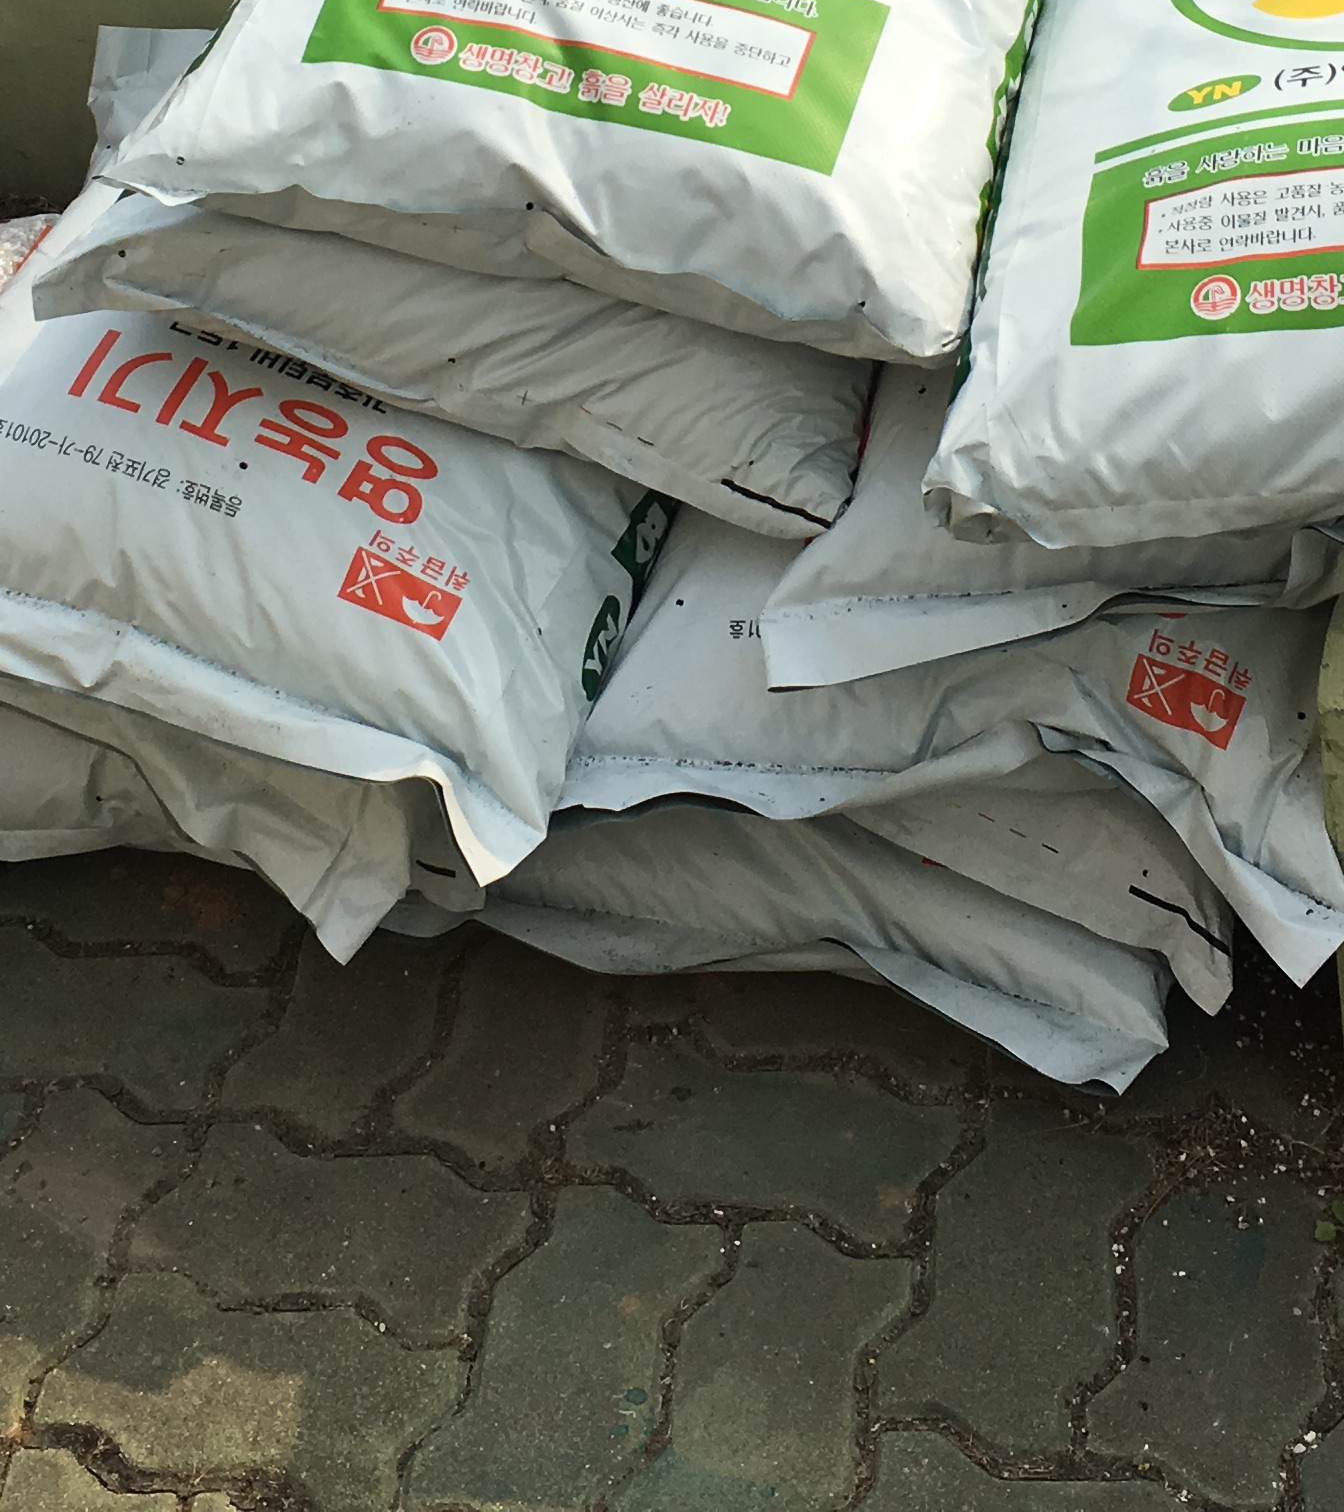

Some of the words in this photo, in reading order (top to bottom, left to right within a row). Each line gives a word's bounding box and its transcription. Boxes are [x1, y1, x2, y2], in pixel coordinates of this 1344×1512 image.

[589, 2, 644, 32] 이상시는
[685, 26, 730, 52] 사용을
[733, 40, 792, 69] 중단하고
[458, 41, 574, 93] 생명창고!
[578, 68, 632, 106] 흙을
[638, 83, 731, 128] 살리자!
[1187, 81, 1242, 104] YN
[1142, 160, 1189, 188] 흙을
[1196, 141, 1288, 174] 사랑하는
[1221, 189, 1267, 207] 사용은
[1275, 183, 1322, 202] 고품질
[1164, 235, 1213, 255] 본사로
[1167, 215, 1213, 233] 사용중
[1221, 210, 1267, 228] 이물질
[68, 329, 439, 525] 영농지기
[105, 449, 172, 490] 경기포천
[369, 529, 472, 593] 취급주의
[1147, 626, 1254, 693] 취급주의
